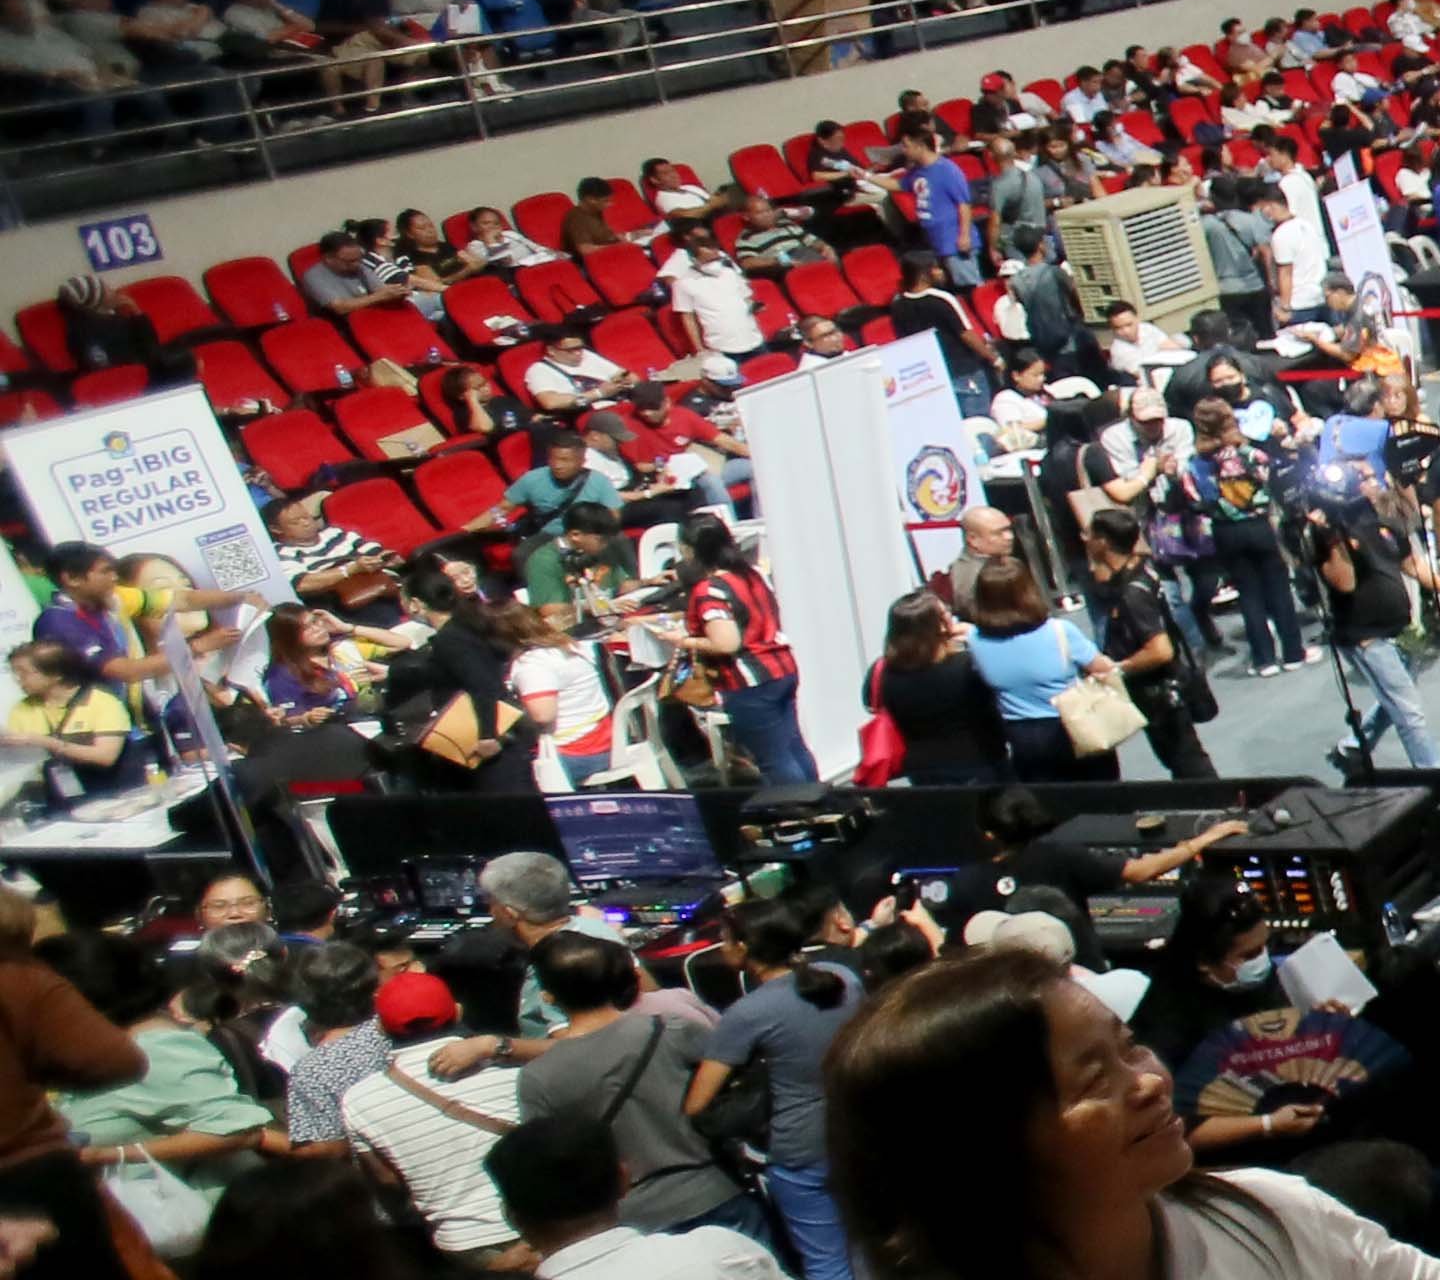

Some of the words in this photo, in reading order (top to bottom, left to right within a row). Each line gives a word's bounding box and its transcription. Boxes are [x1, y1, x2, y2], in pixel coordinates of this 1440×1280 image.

[84, 220, 158, 265] 103
[68, 445, 193, 494] Pag-IBIG
[80, 469, 204, 517] REGULAR
[90, 490, 213, 539] SAVINGS
